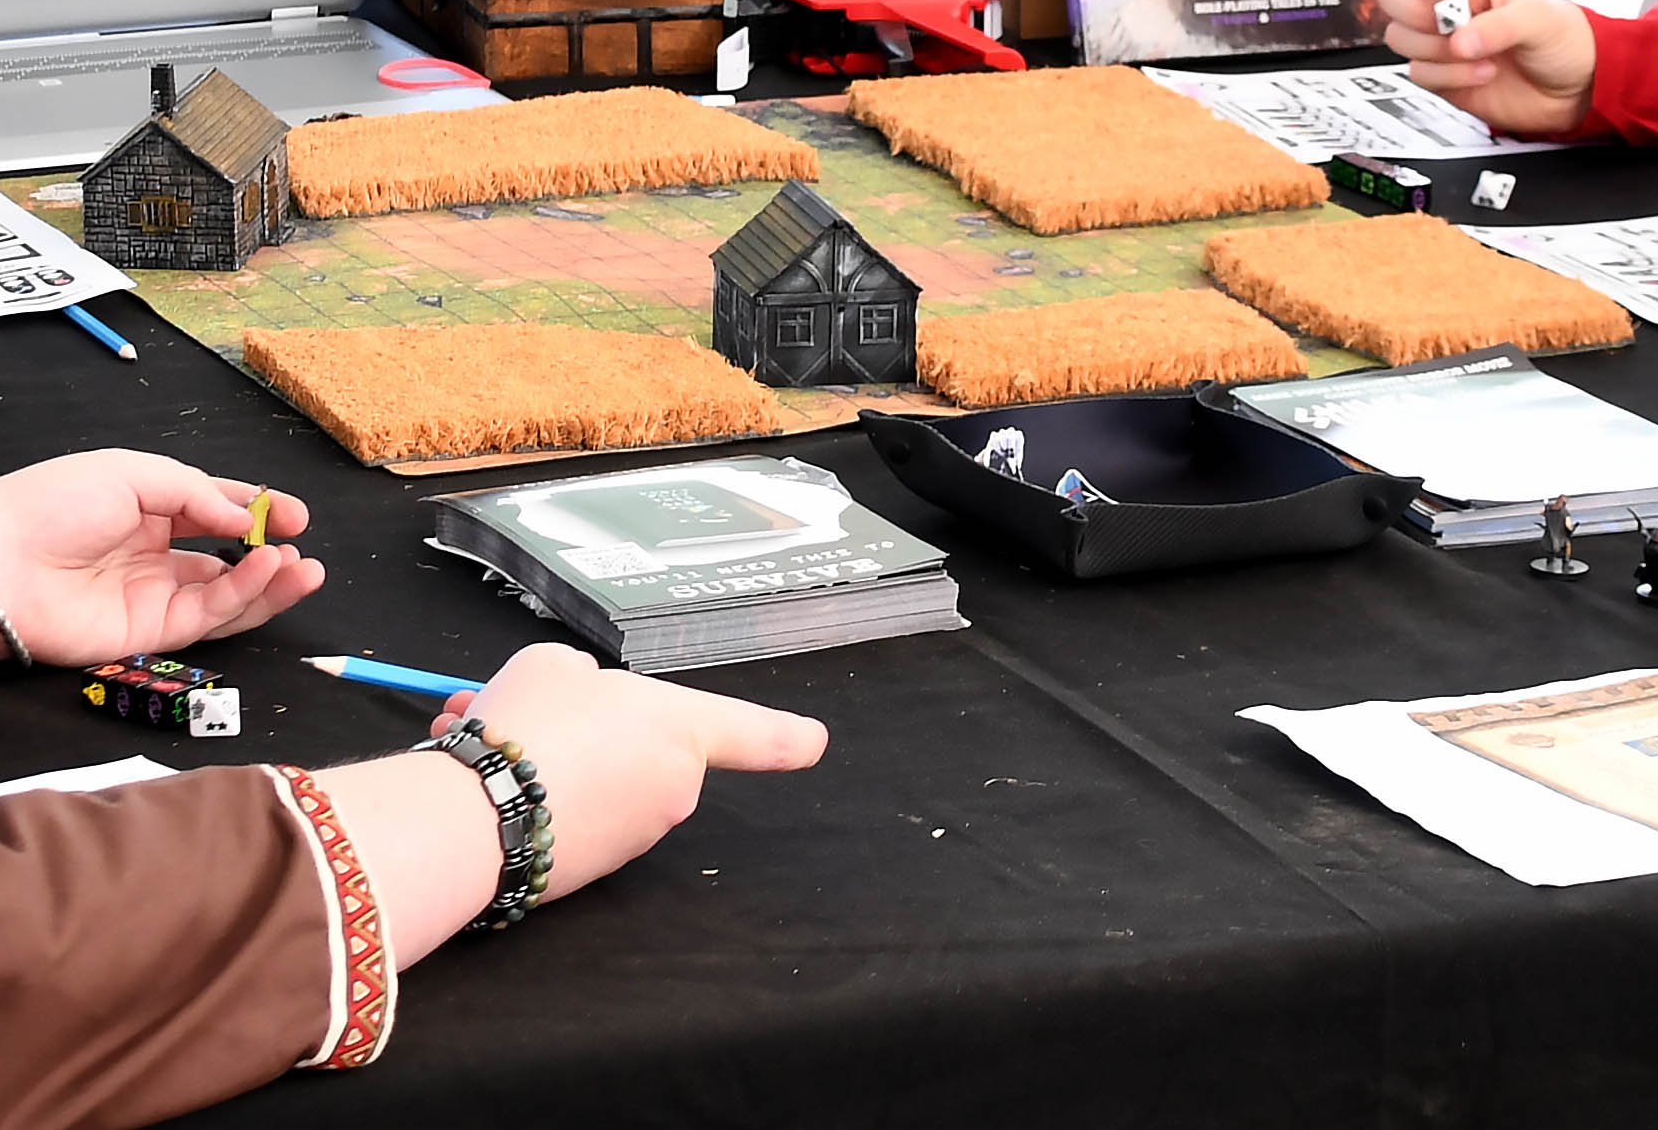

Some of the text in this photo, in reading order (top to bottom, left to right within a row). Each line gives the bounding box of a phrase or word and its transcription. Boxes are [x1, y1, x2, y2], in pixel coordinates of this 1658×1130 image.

[716, 560, 777, 575] NEED
[791, 548, 853, 565] THIS
[864, 541, 895, 552] TO
[668, 558, 884, 599] SURVIVE
